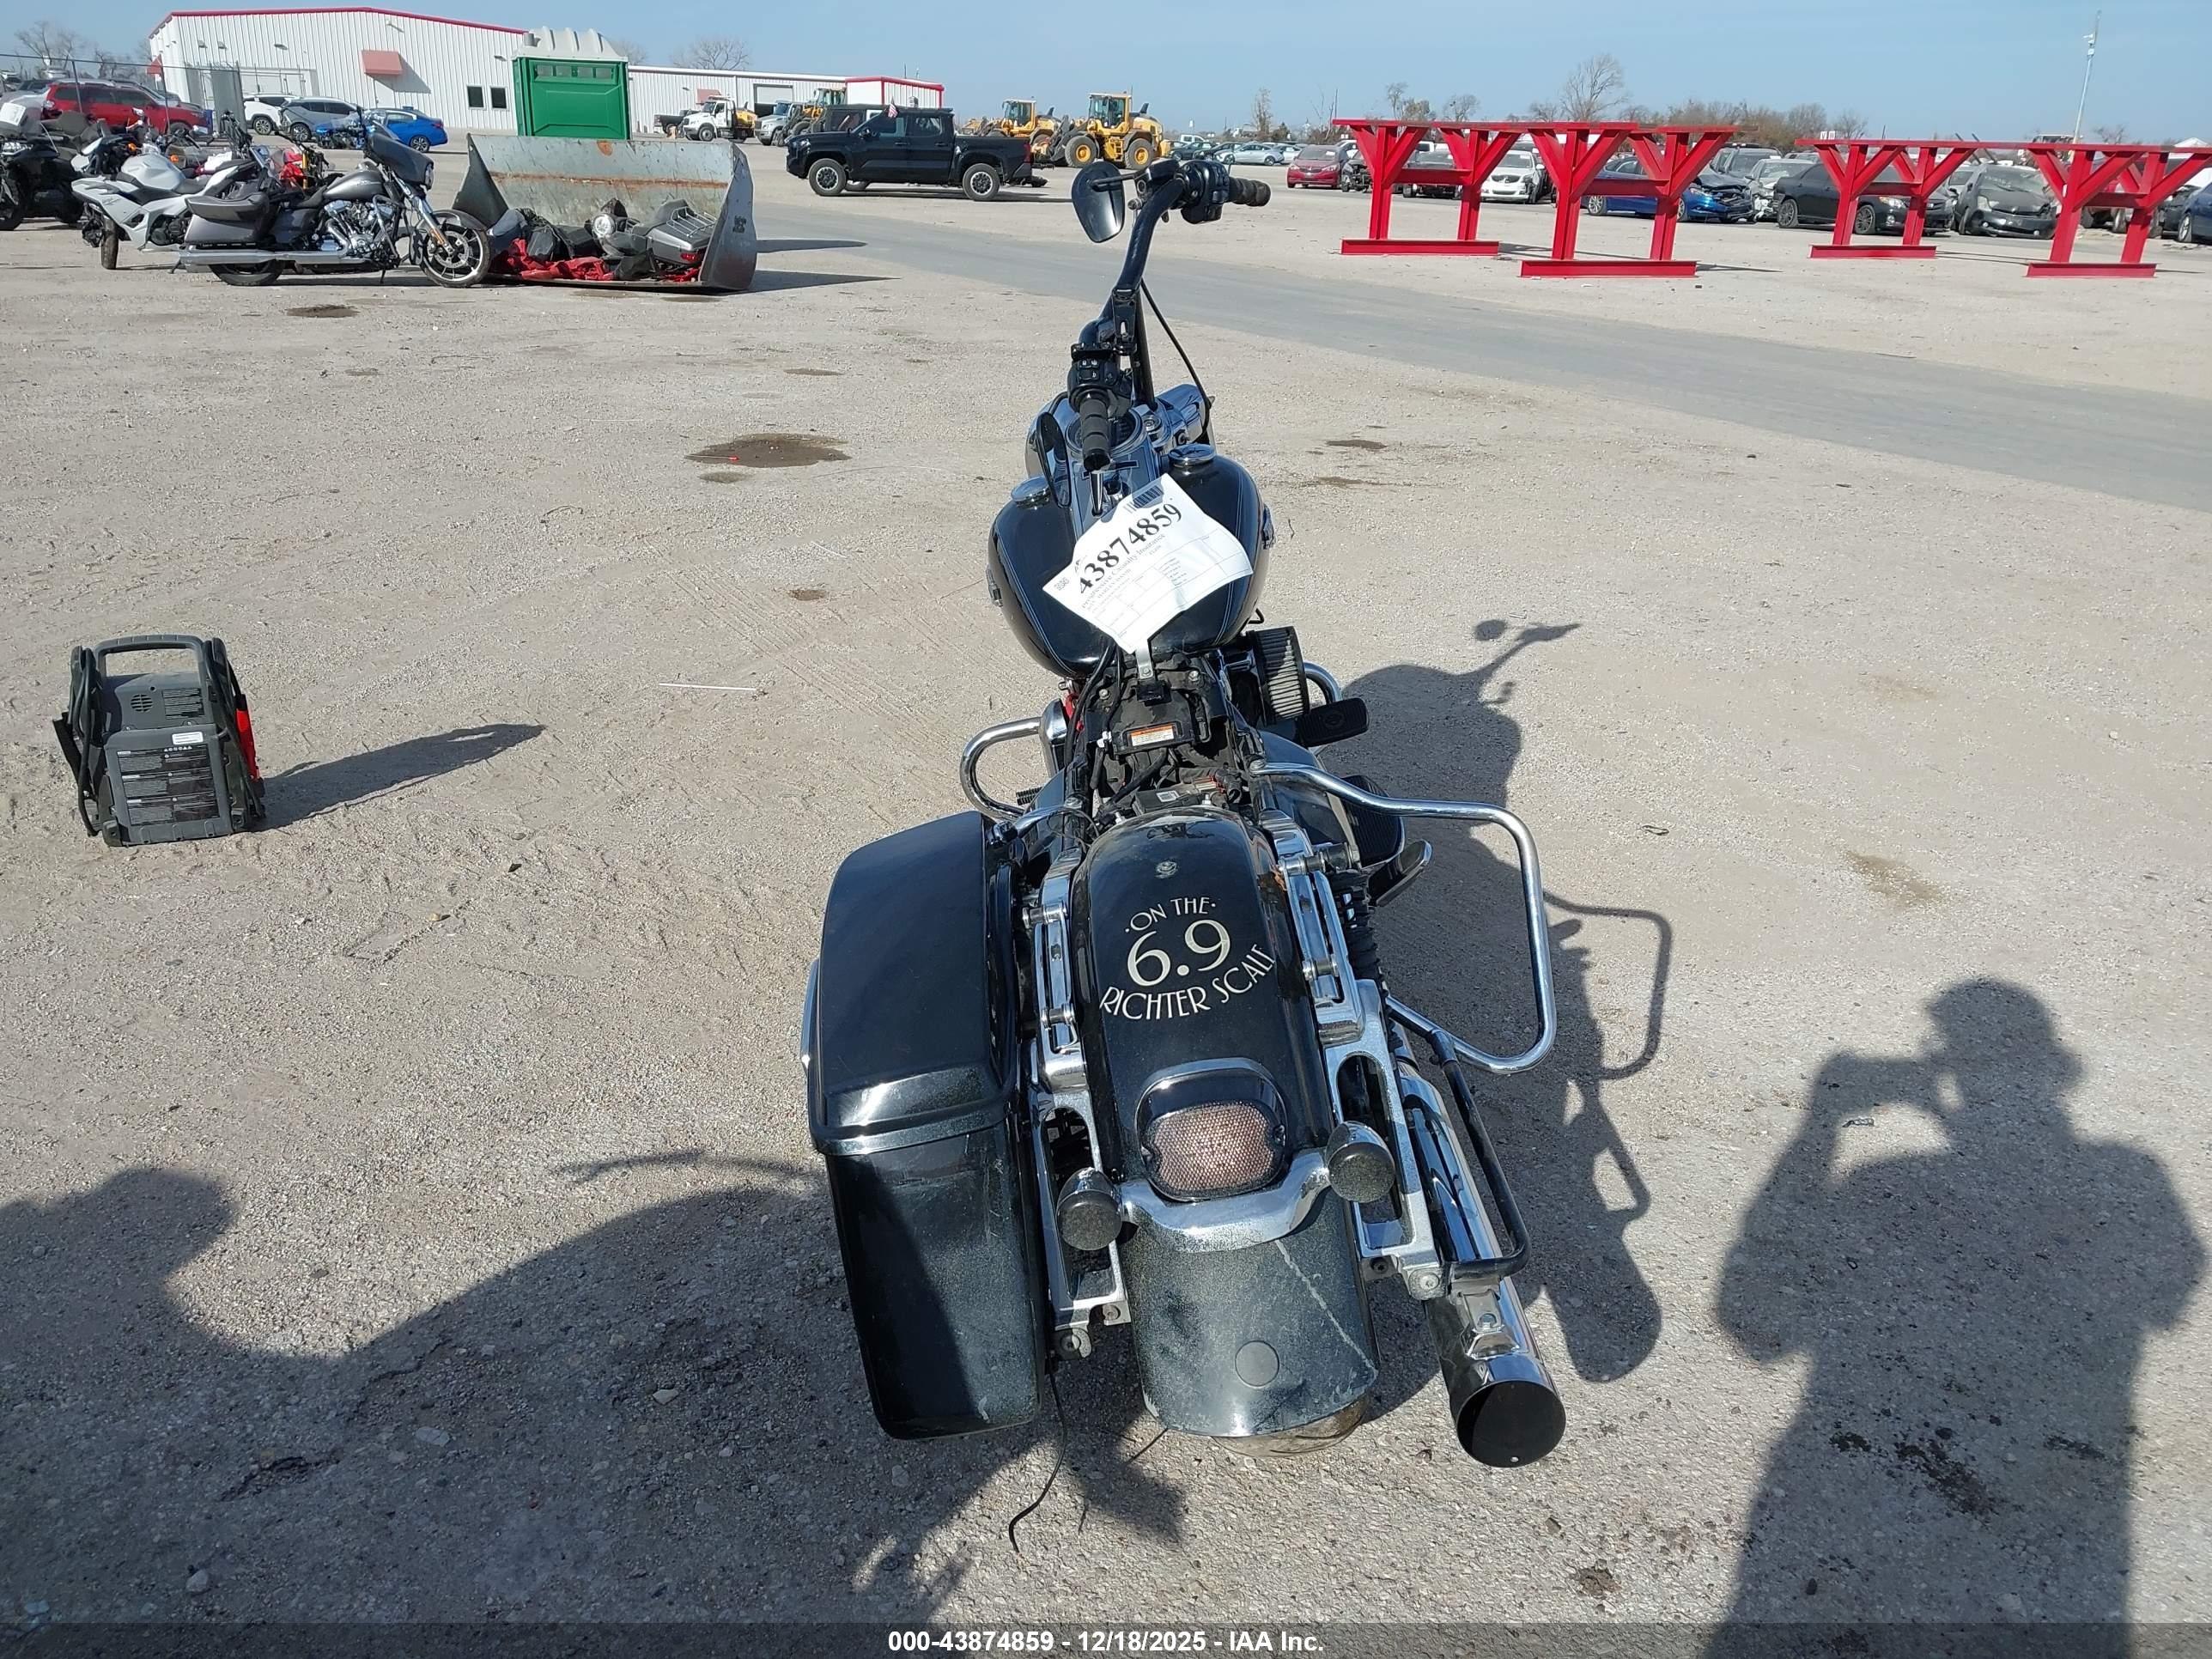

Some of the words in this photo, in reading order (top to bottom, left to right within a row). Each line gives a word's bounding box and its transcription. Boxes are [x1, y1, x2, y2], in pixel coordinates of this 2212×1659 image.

[1080, 503, 1182, 593] 43874859
[1127, 919, 1231, 987] 6.9
[1099, 986, 1212, 1020] RICHTER
